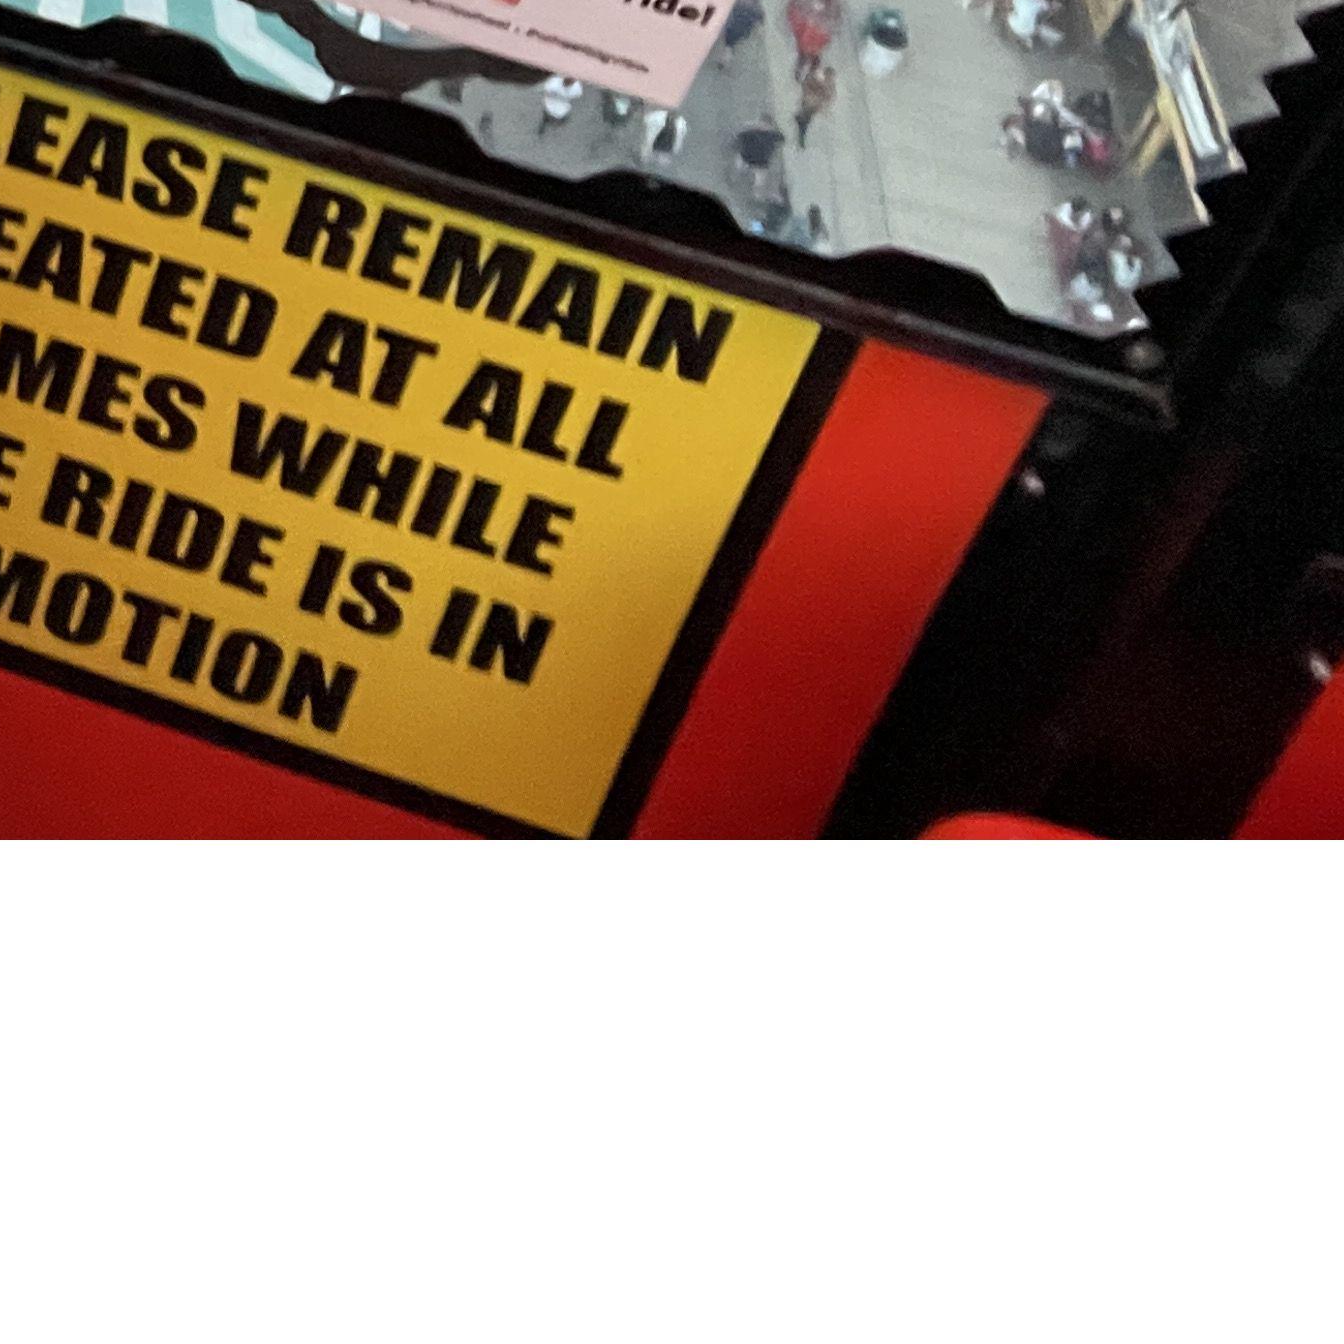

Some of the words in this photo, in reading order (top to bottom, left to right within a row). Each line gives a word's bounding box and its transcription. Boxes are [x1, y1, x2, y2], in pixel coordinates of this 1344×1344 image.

[282, 181, 733, 383] REMAIN
[230, 401, 574, 576] WHILE
[290, 310, 438, 407] AT
[442, 361, 628, 479] ALL
[40, 455, 284, 597] RIDE
[298, 544, 413, 636] IS
[429, 587, 554, 685] IN
